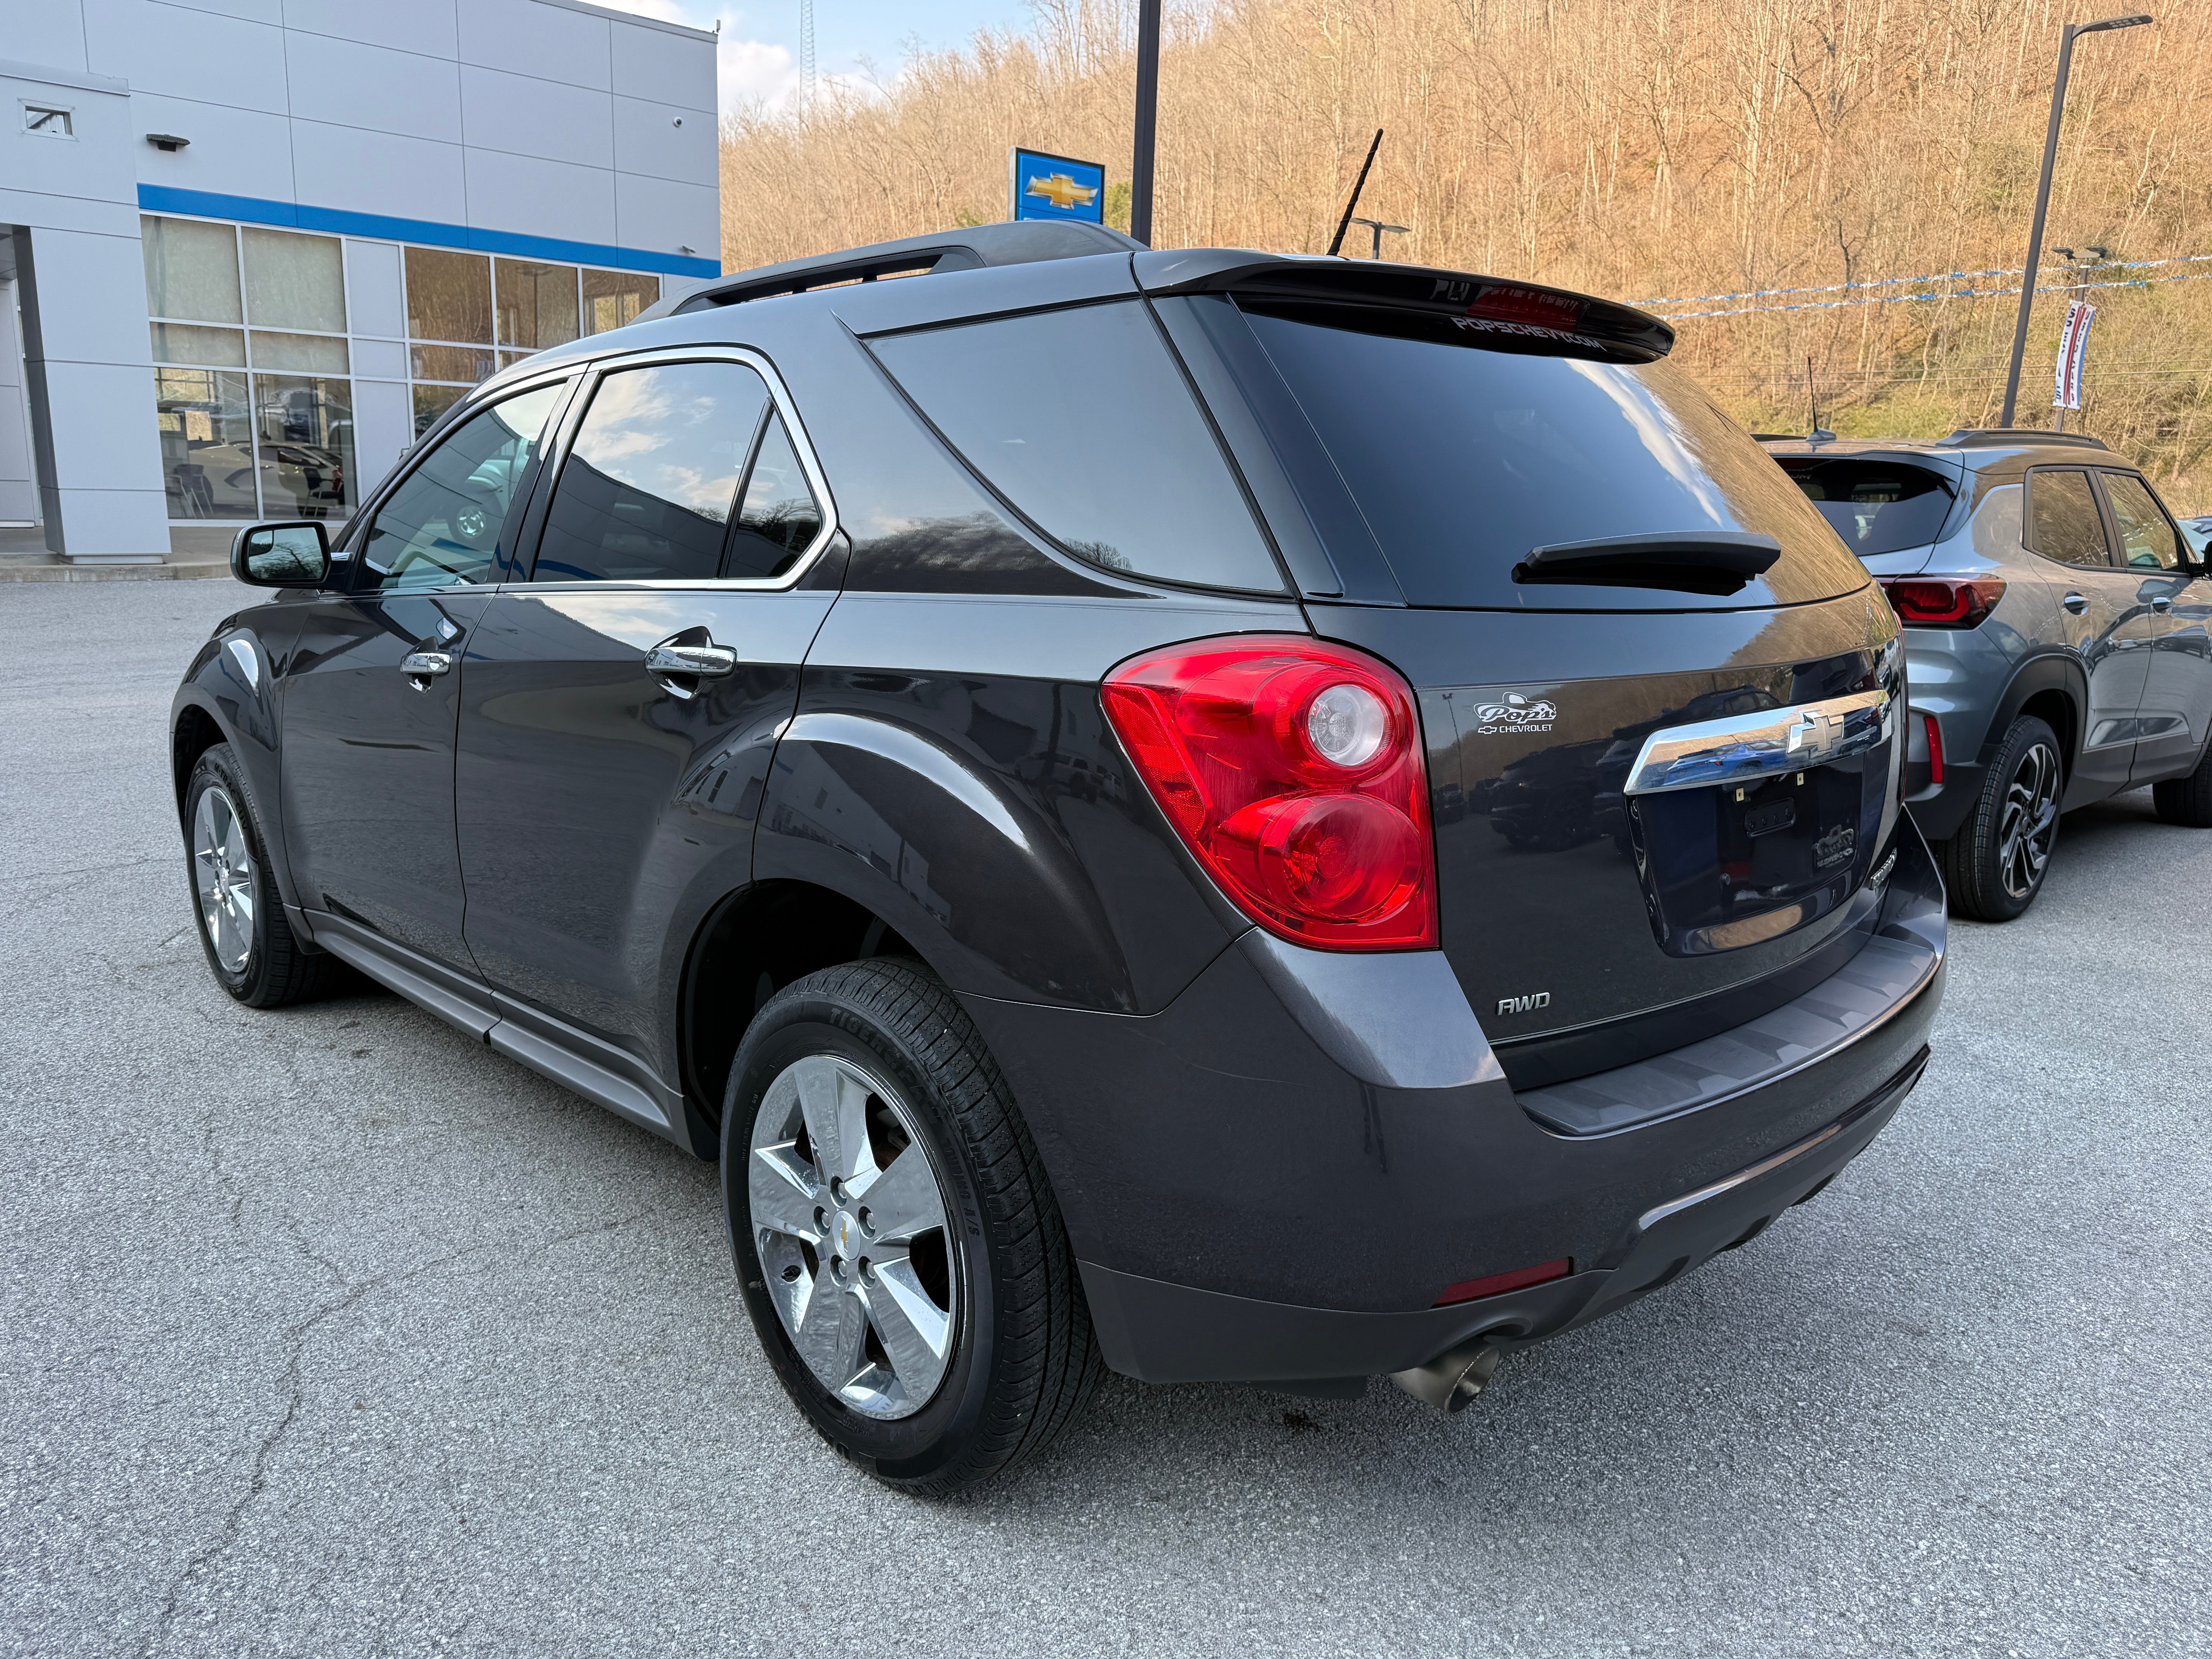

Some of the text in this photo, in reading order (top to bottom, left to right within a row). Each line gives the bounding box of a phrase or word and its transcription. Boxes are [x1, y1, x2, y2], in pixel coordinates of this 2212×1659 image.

[1450, 317, 1607, 352] POPSCHEVY.COM
[1499, 724, 1553, 733] CHEVROLET
[1497, 992, 1550, 1016] AWD
[829, 1007, 888, 1055] TIGER
[963, 1206, 980, 1237] A/S
